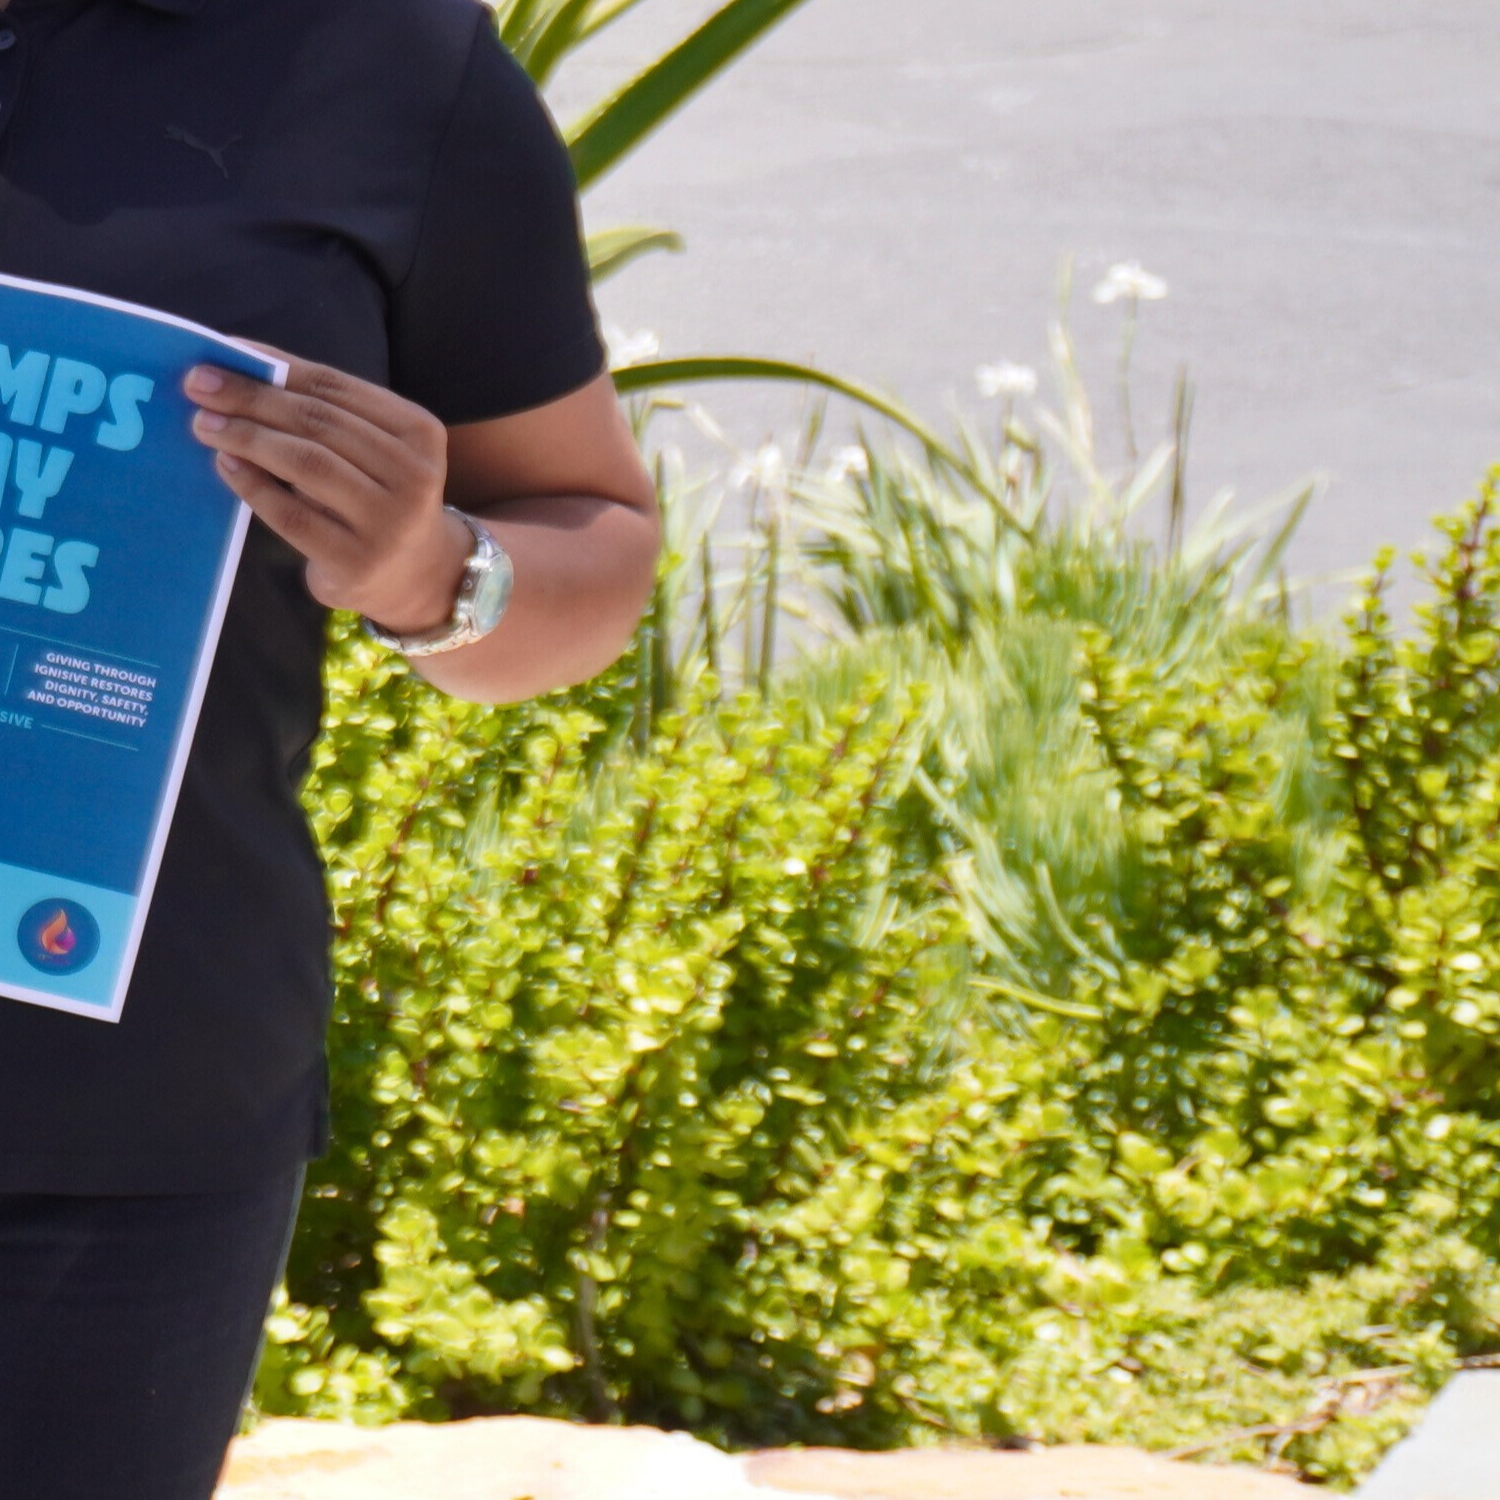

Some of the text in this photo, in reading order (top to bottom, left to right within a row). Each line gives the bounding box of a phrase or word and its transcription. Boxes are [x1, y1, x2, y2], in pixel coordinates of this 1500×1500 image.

[34, 663, 153, 702] IGNISIVE RESTORES
[46, 652, 157, 688] GIVING THROUGH
[27, 690, 147, 728] AND OPPORTUNITY
[44, 680, 98, 703] DIGNITY,
